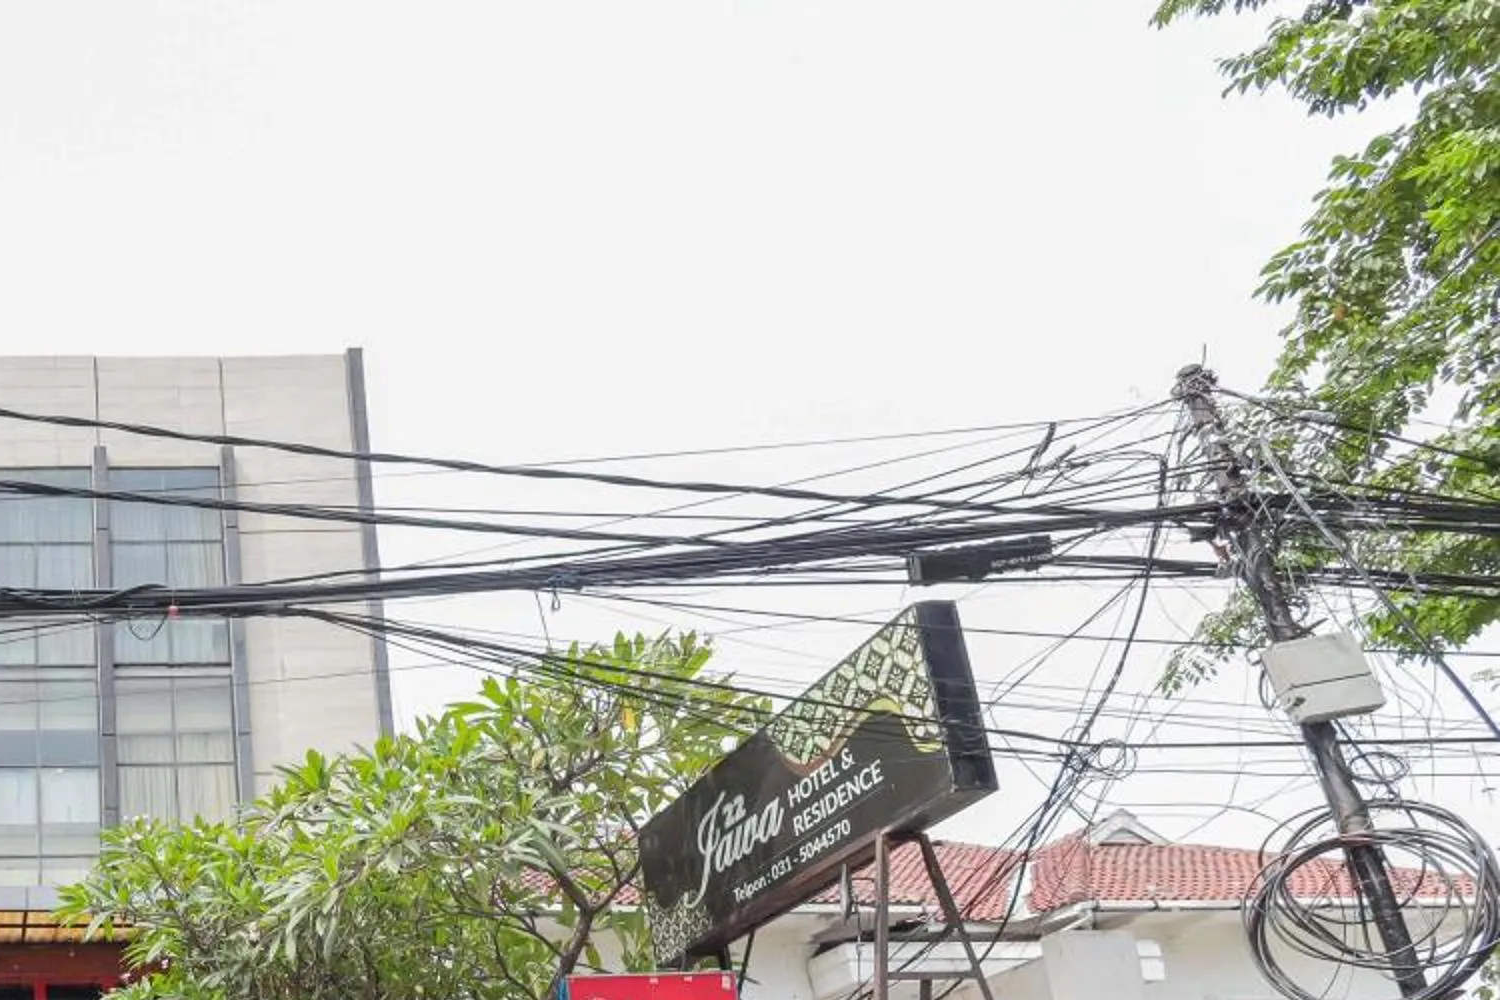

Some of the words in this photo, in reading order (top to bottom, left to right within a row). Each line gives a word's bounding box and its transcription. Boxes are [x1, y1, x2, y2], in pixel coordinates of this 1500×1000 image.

[787, 769, 840, 808] HOTEL
[841, 747, 856, 770] &
[792, 759, 884, 836] RESIDENCE
[722, 794, 747, 829] 22
[684, 790, 785, 908] Jawa
[771, 856, 793, 880] 031
[799, 818, 851, 864] 5044570
